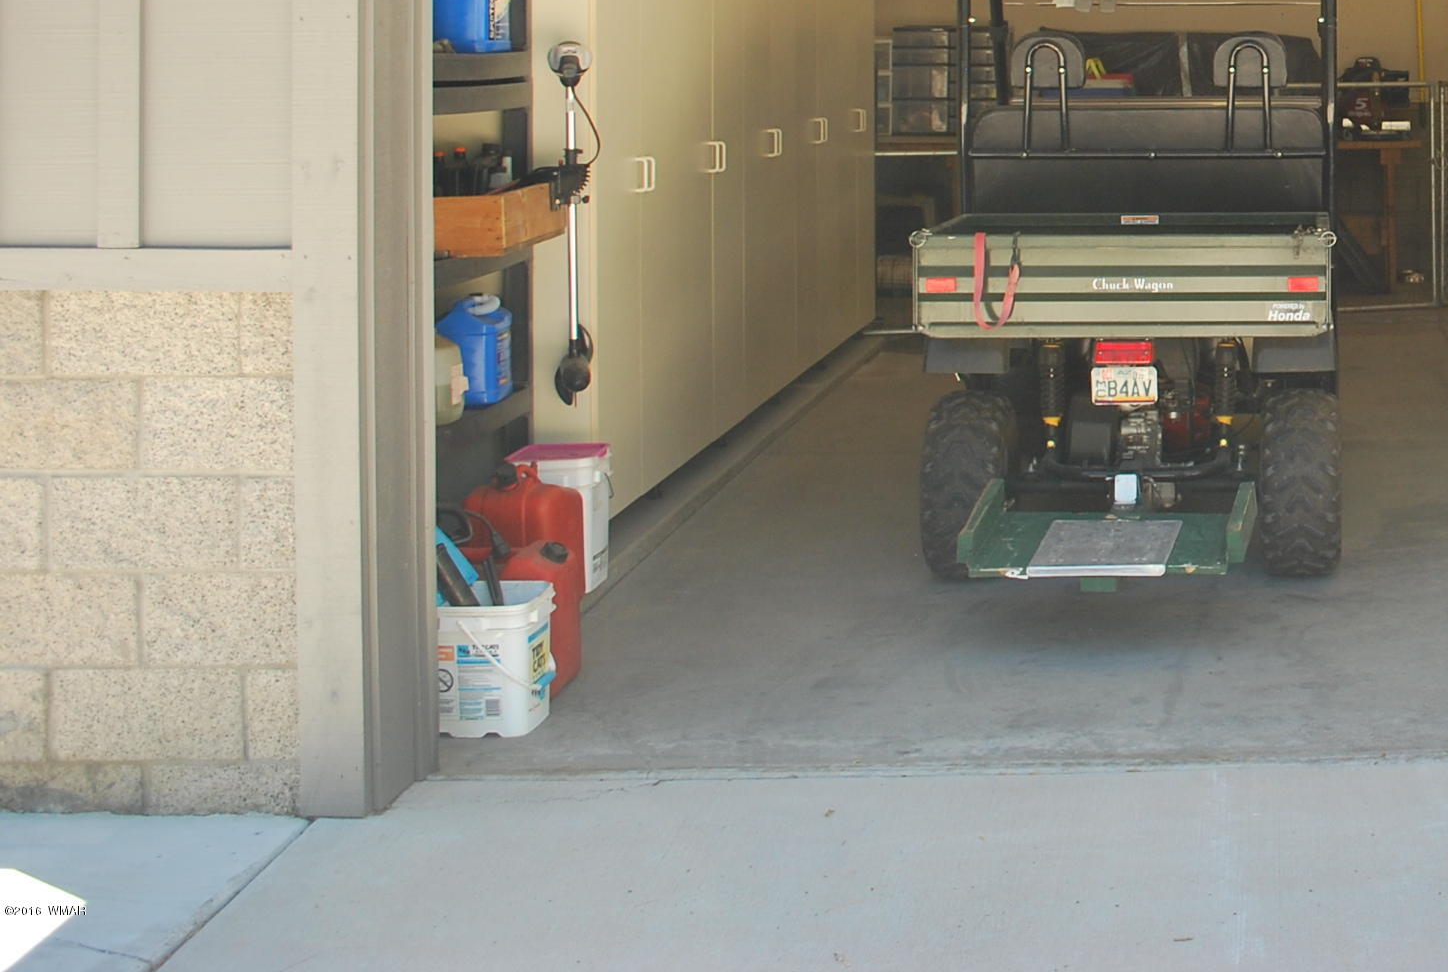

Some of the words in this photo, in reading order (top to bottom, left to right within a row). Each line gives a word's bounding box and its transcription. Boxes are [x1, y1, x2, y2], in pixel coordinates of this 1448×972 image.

[1092, 278, 1129, 290] Chuck
[1134, 278, 1173, 293] Wagon
[1268, 310, 1310, 321] Honda
[1108, 380, 1152, 397] B4AV
